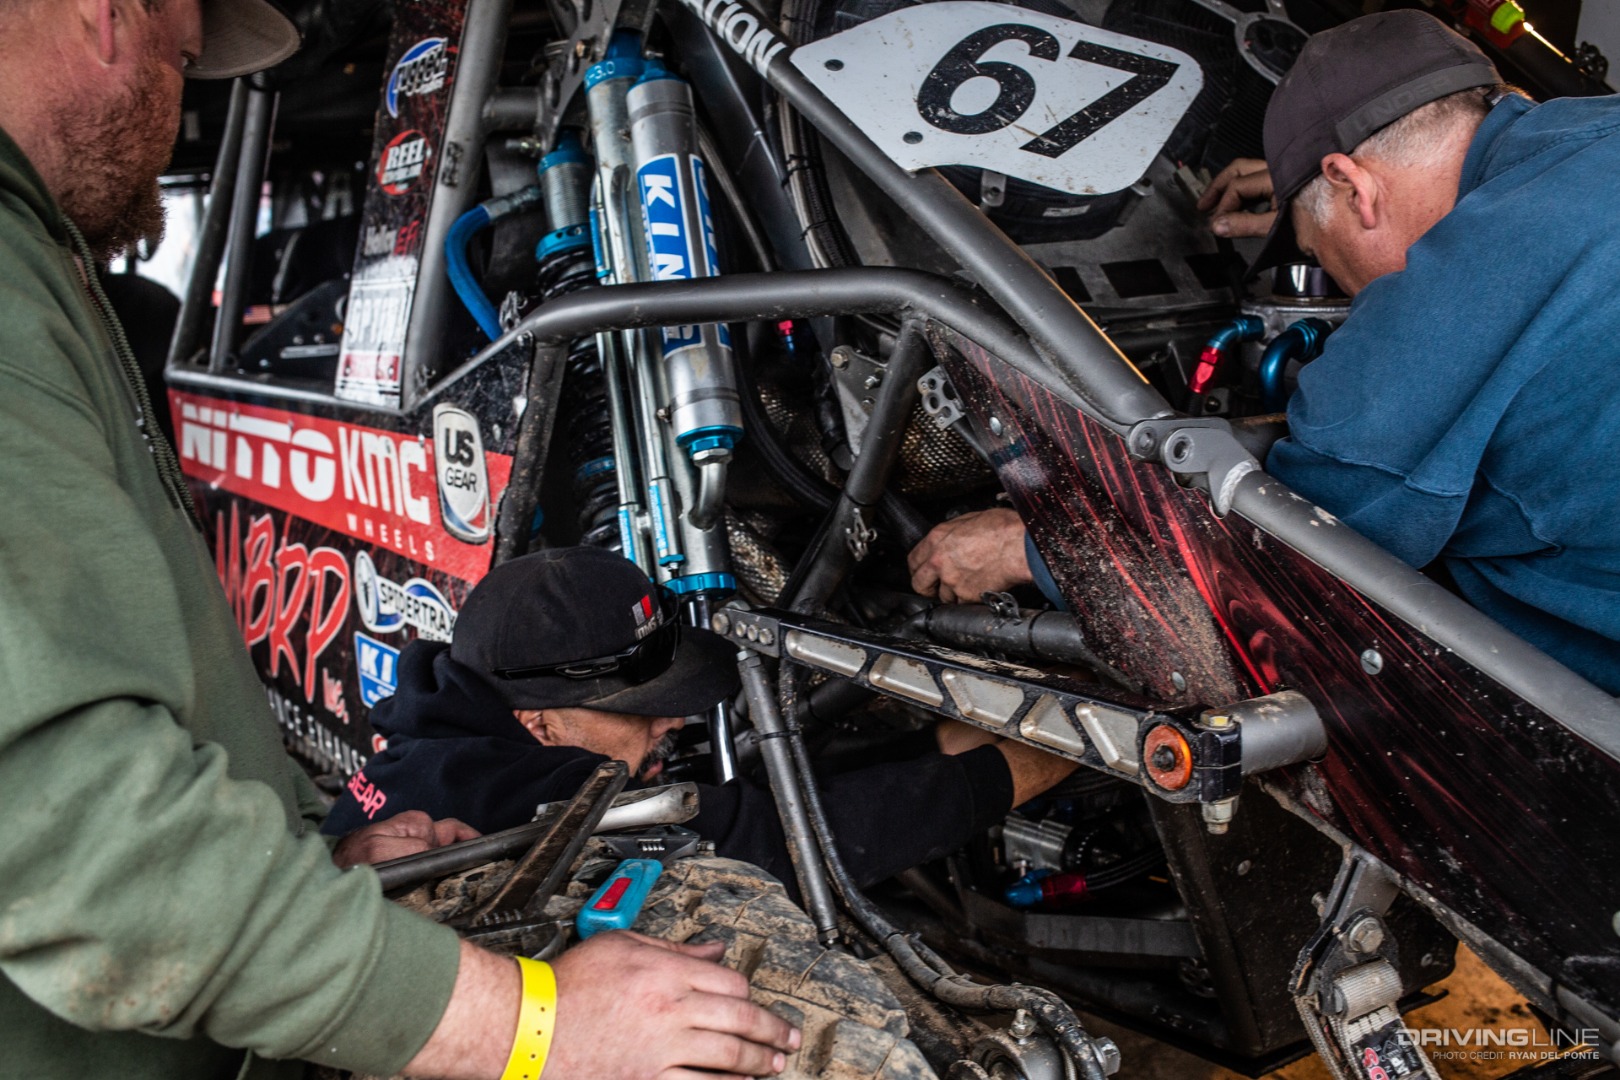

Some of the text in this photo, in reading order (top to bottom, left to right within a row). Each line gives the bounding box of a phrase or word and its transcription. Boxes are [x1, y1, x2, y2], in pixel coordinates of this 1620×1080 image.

[680, 0, 787, 79] TION
[917, 23, 1180, 159] 67
[385, 138, 426, 171] REEL
[182, 402, 336, 502] NITTO
[445, 427, 475, 468] US
[445, 467, 478, 493] GEAR
[347, 513, 435, 562] WHEELS
[361, 643, 394, 684] KI
